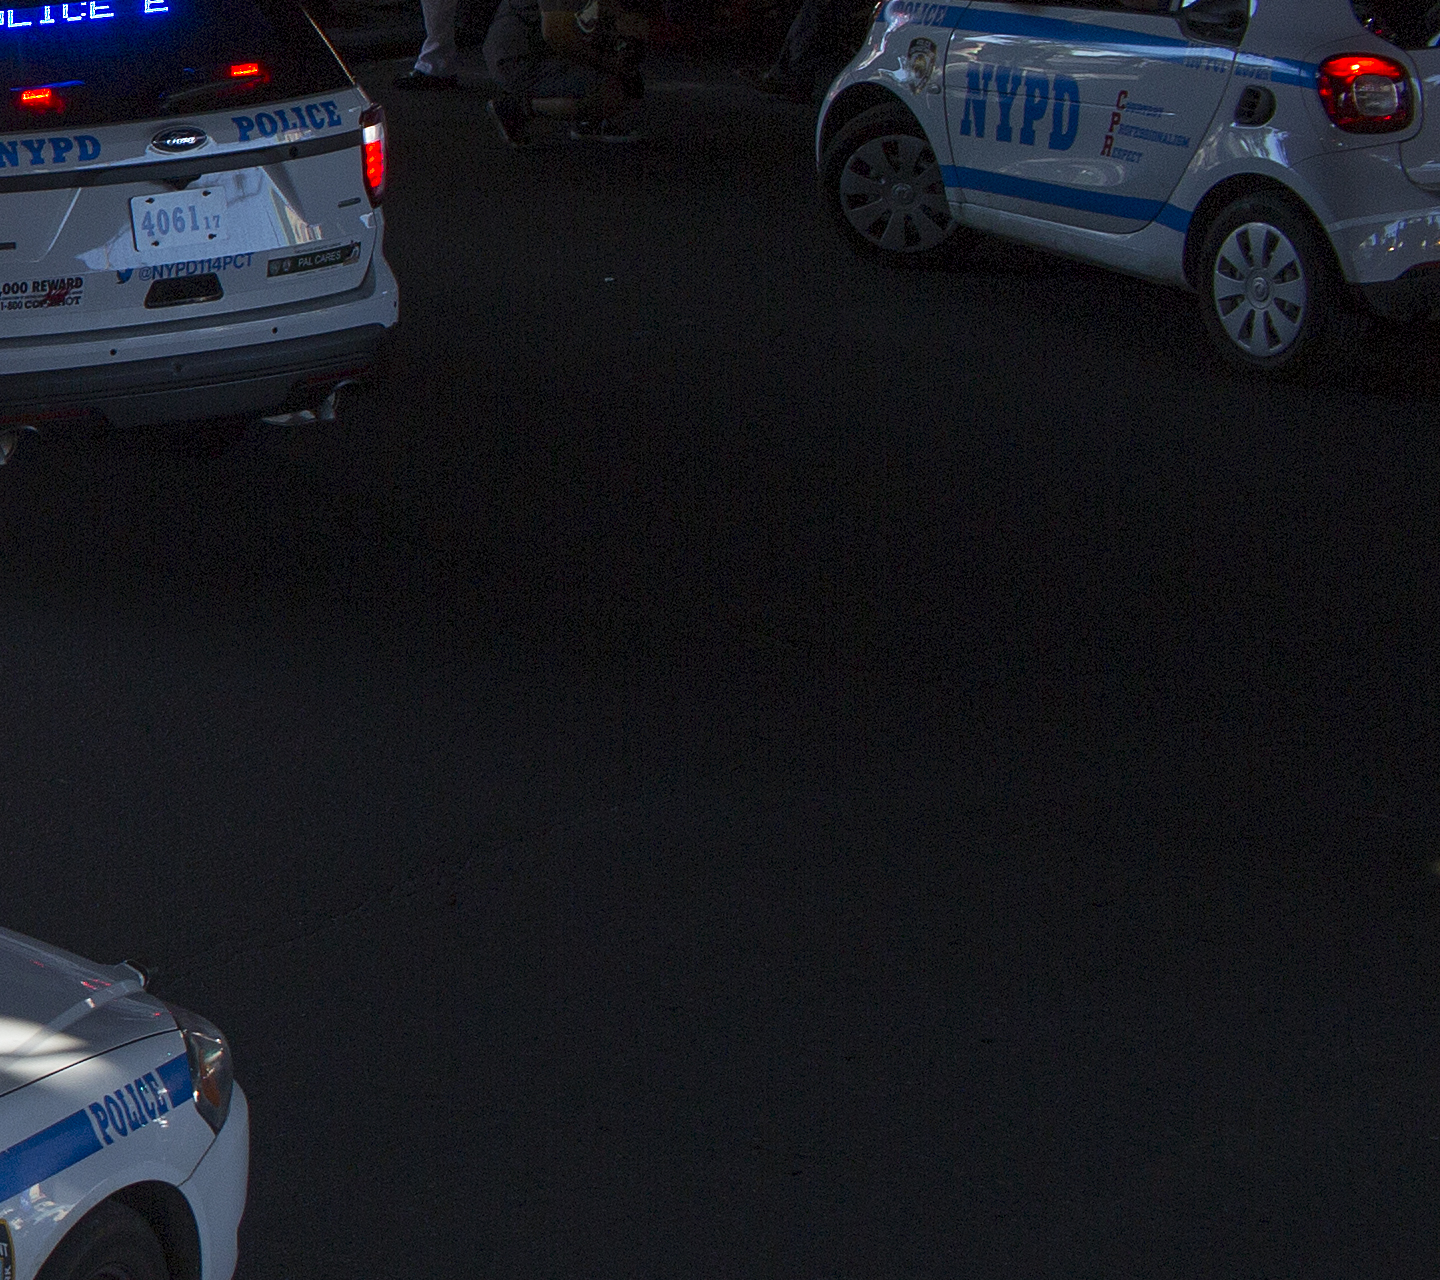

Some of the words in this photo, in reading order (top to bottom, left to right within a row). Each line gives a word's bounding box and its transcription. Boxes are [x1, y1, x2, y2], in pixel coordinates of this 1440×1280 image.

[230, 100, 343, 142] POLICE
[960, 65, 1081, 151] NYPD
[1100, 134, 1143, 163] RESPECT
[141, 205, 200, 238] 4061
[204, 215, 221, 231] 17
[32, 277, 84, 293] REWARD
[88, 1071, 171, 1146] POLICE
